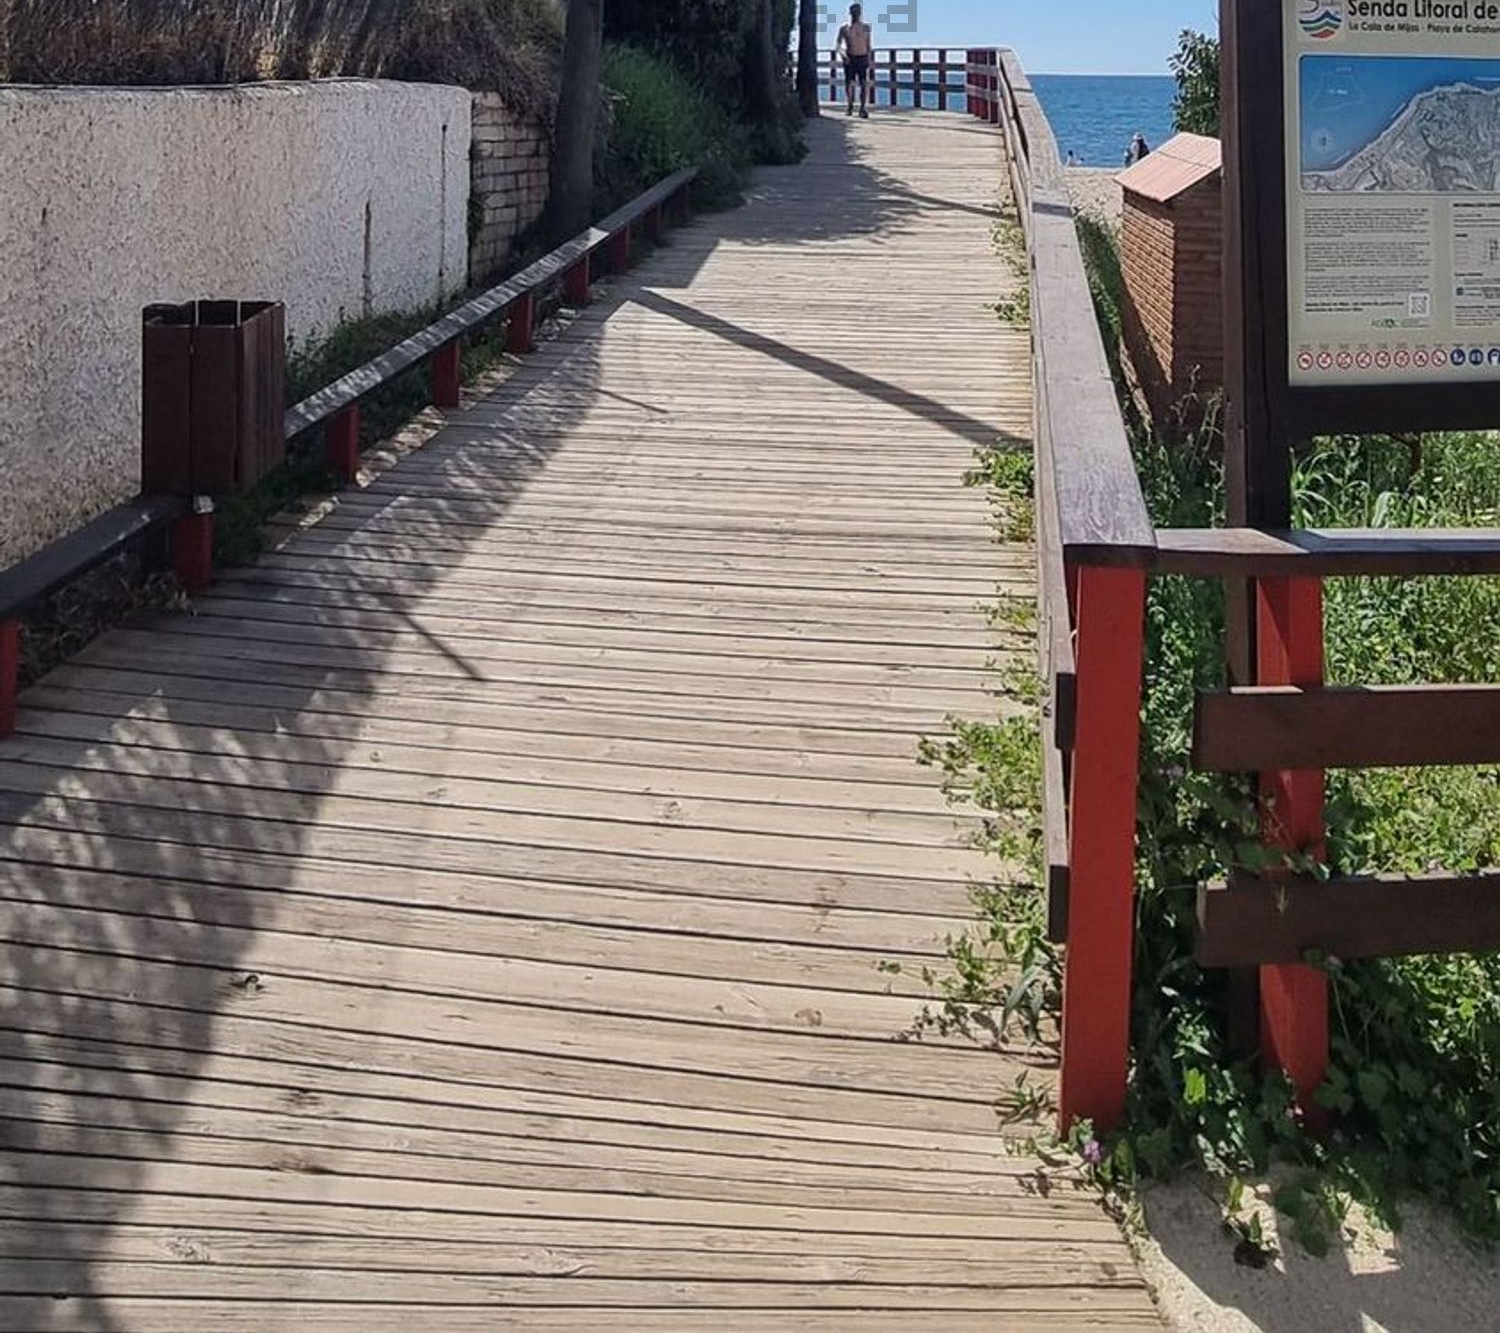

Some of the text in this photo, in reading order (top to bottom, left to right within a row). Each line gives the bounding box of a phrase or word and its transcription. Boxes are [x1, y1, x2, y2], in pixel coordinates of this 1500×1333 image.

[1474, 0, 1498, 19] de
[1383, 22, 1395, 32] de
[1452, 23, 1463, 33] de
